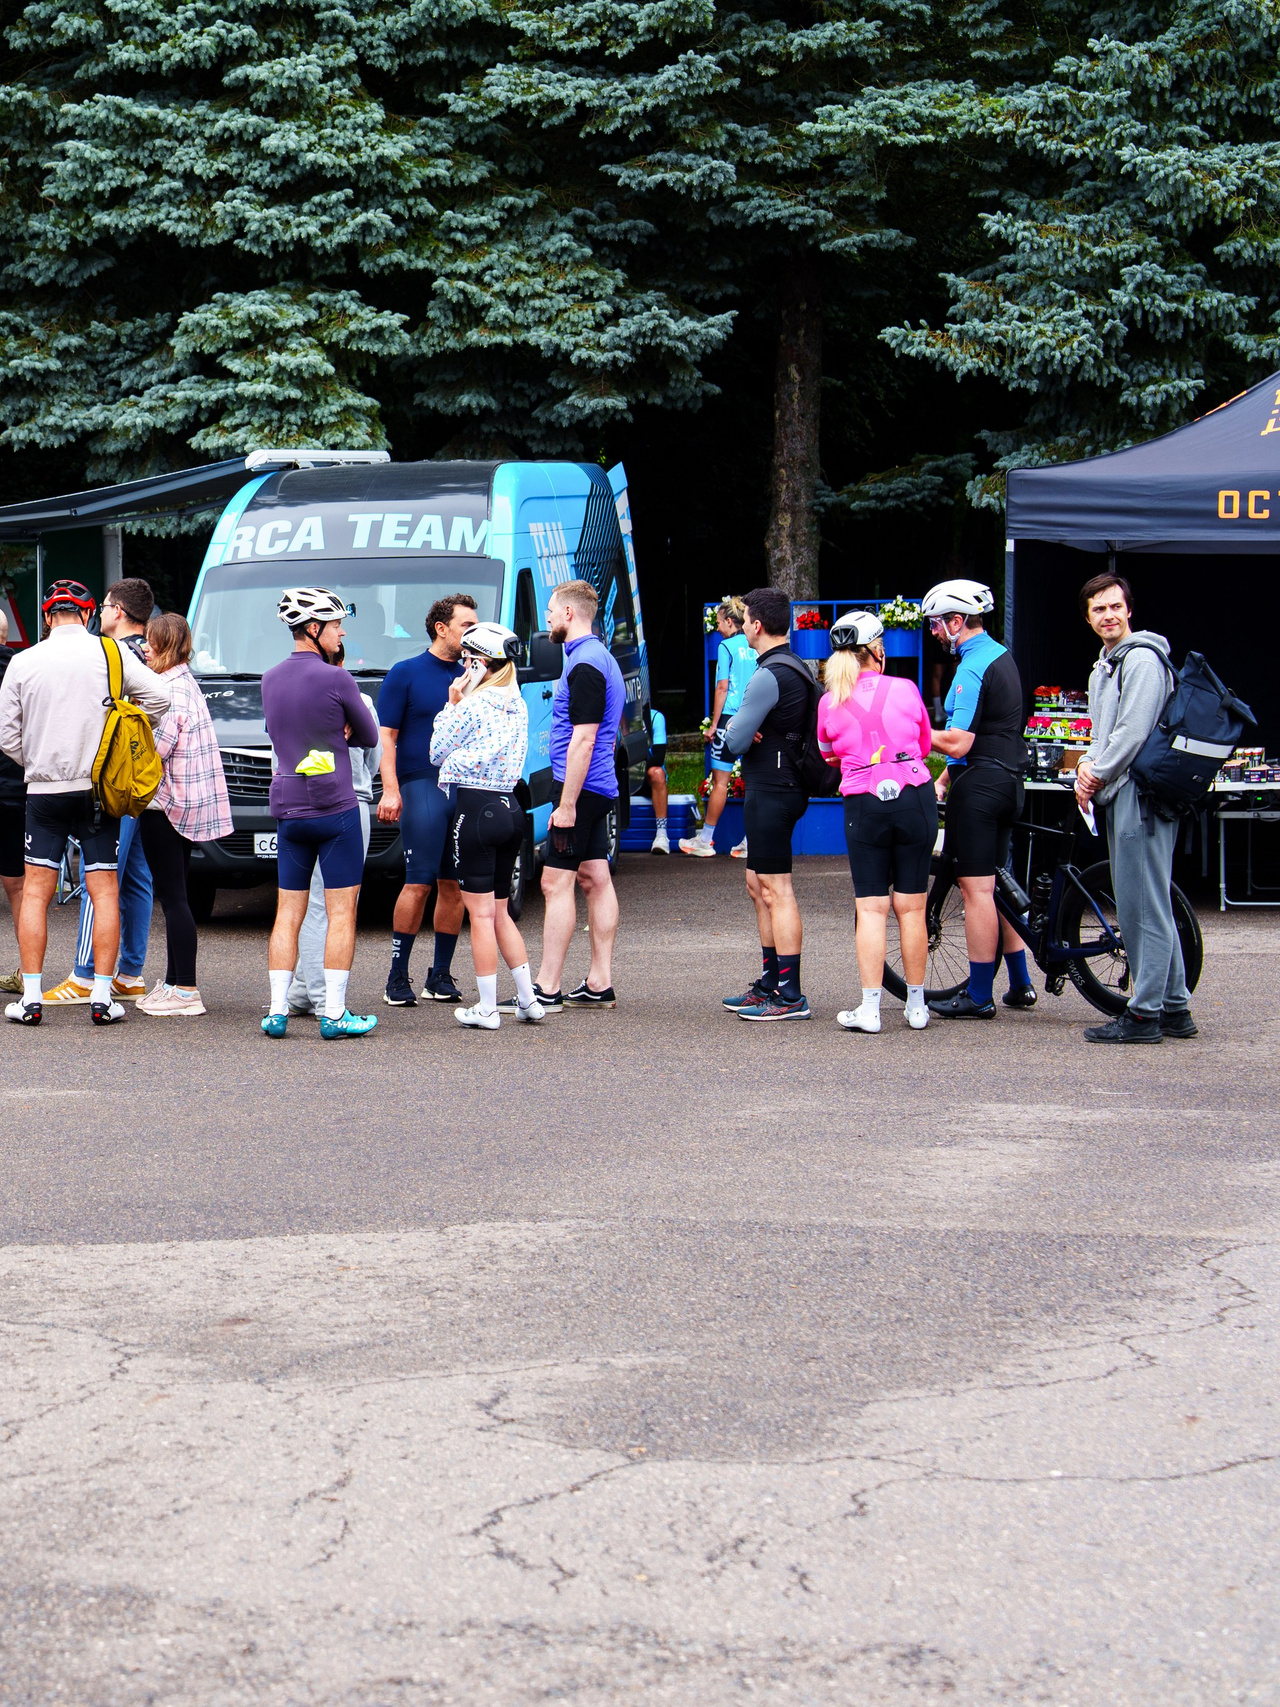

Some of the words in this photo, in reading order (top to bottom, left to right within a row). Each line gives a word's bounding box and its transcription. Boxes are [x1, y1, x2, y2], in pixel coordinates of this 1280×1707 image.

[227, 516, 325, 561] RCA
[347, 513, 489, 554] TEAM
[710, 728, 726, 760] RCA
[1066, 959, 1086, 987] SWISS
